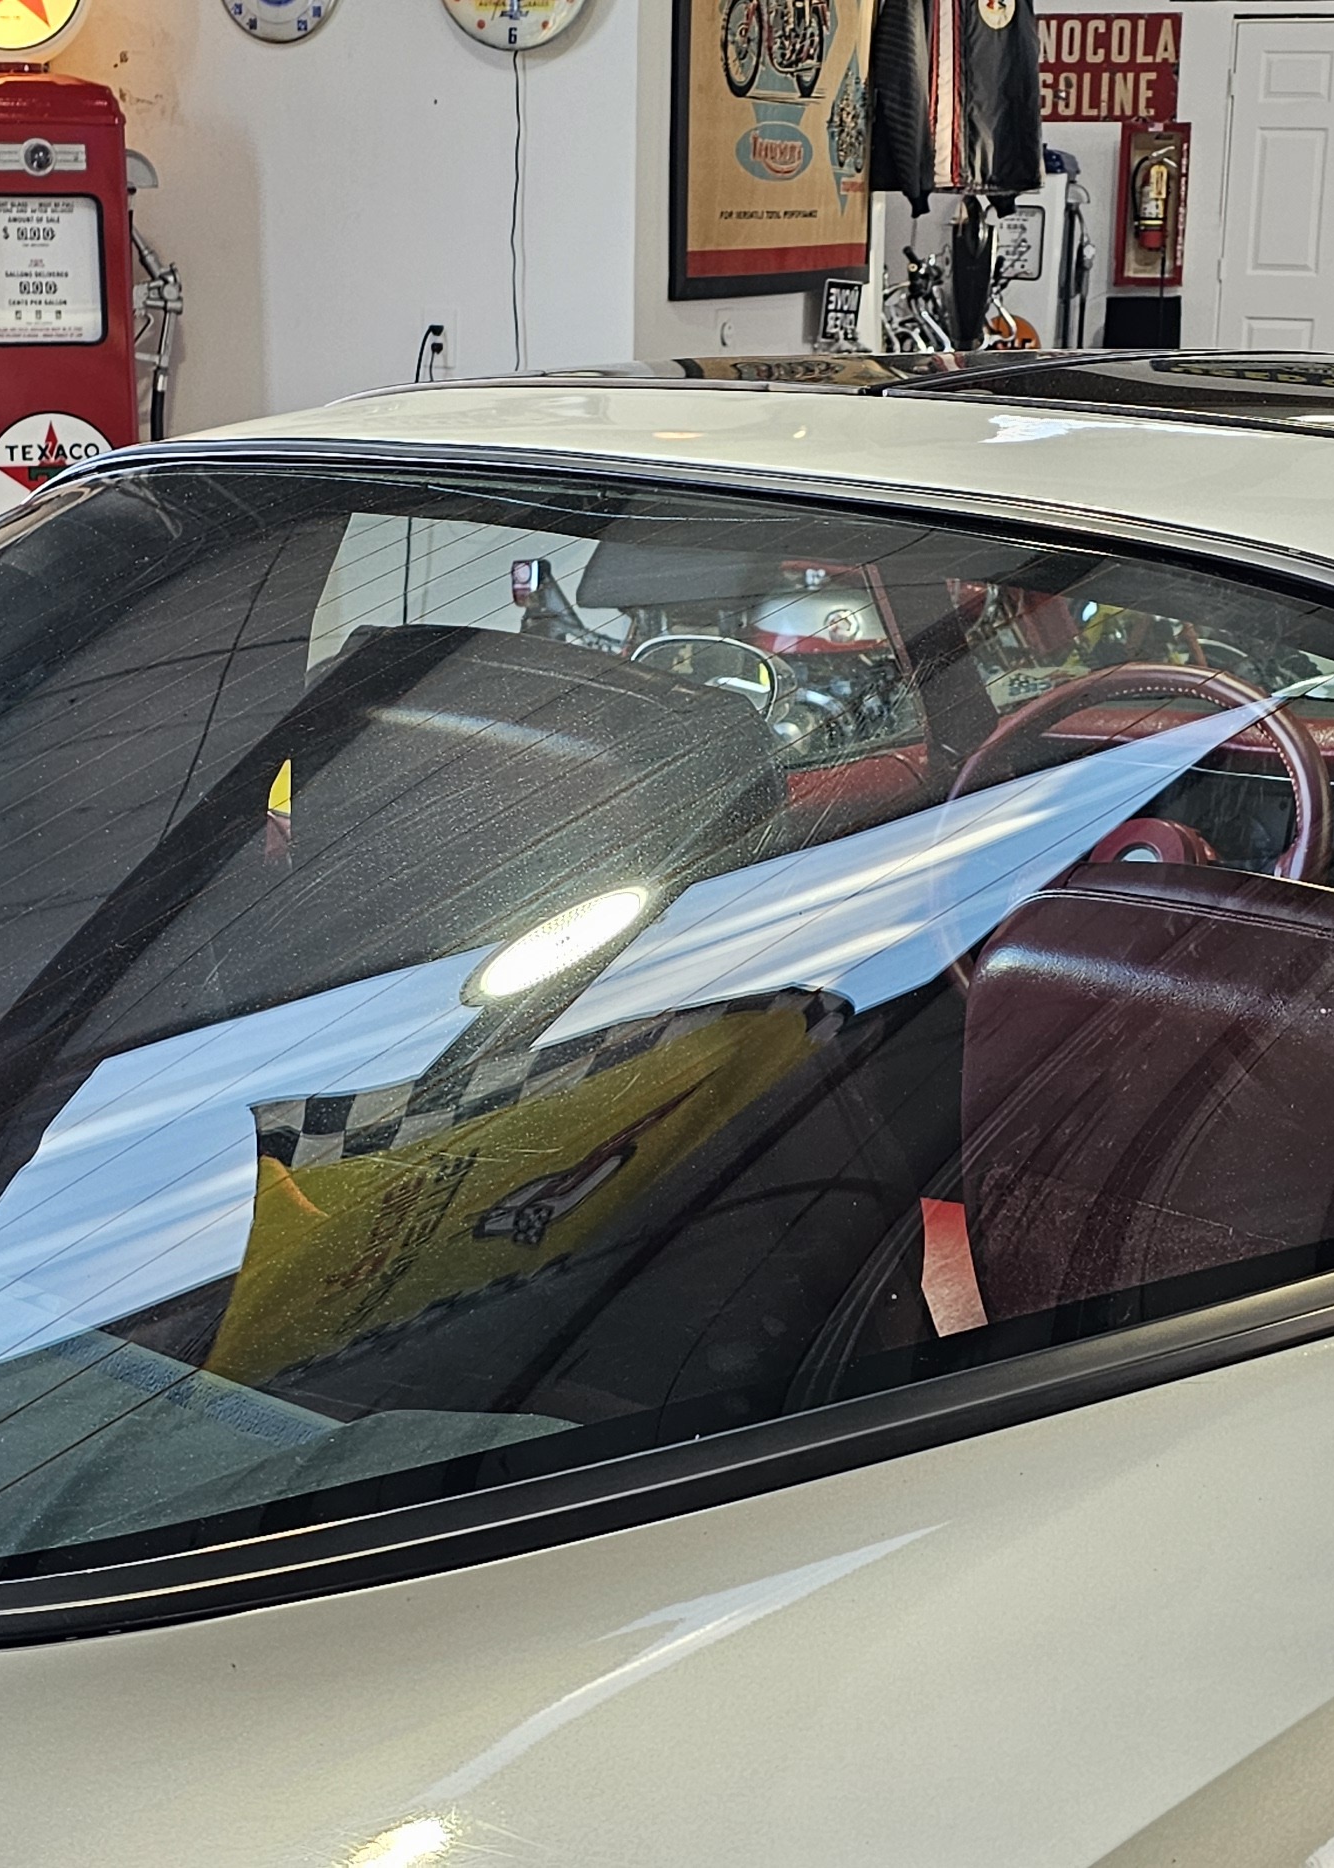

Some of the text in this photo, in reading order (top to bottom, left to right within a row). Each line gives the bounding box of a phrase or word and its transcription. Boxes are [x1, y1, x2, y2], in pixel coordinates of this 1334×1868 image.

[508, 27, 517, 45] 6
[1038, 19, 1176, 63] NOCOLA
[5, 443, 100, 462] TEXACO
